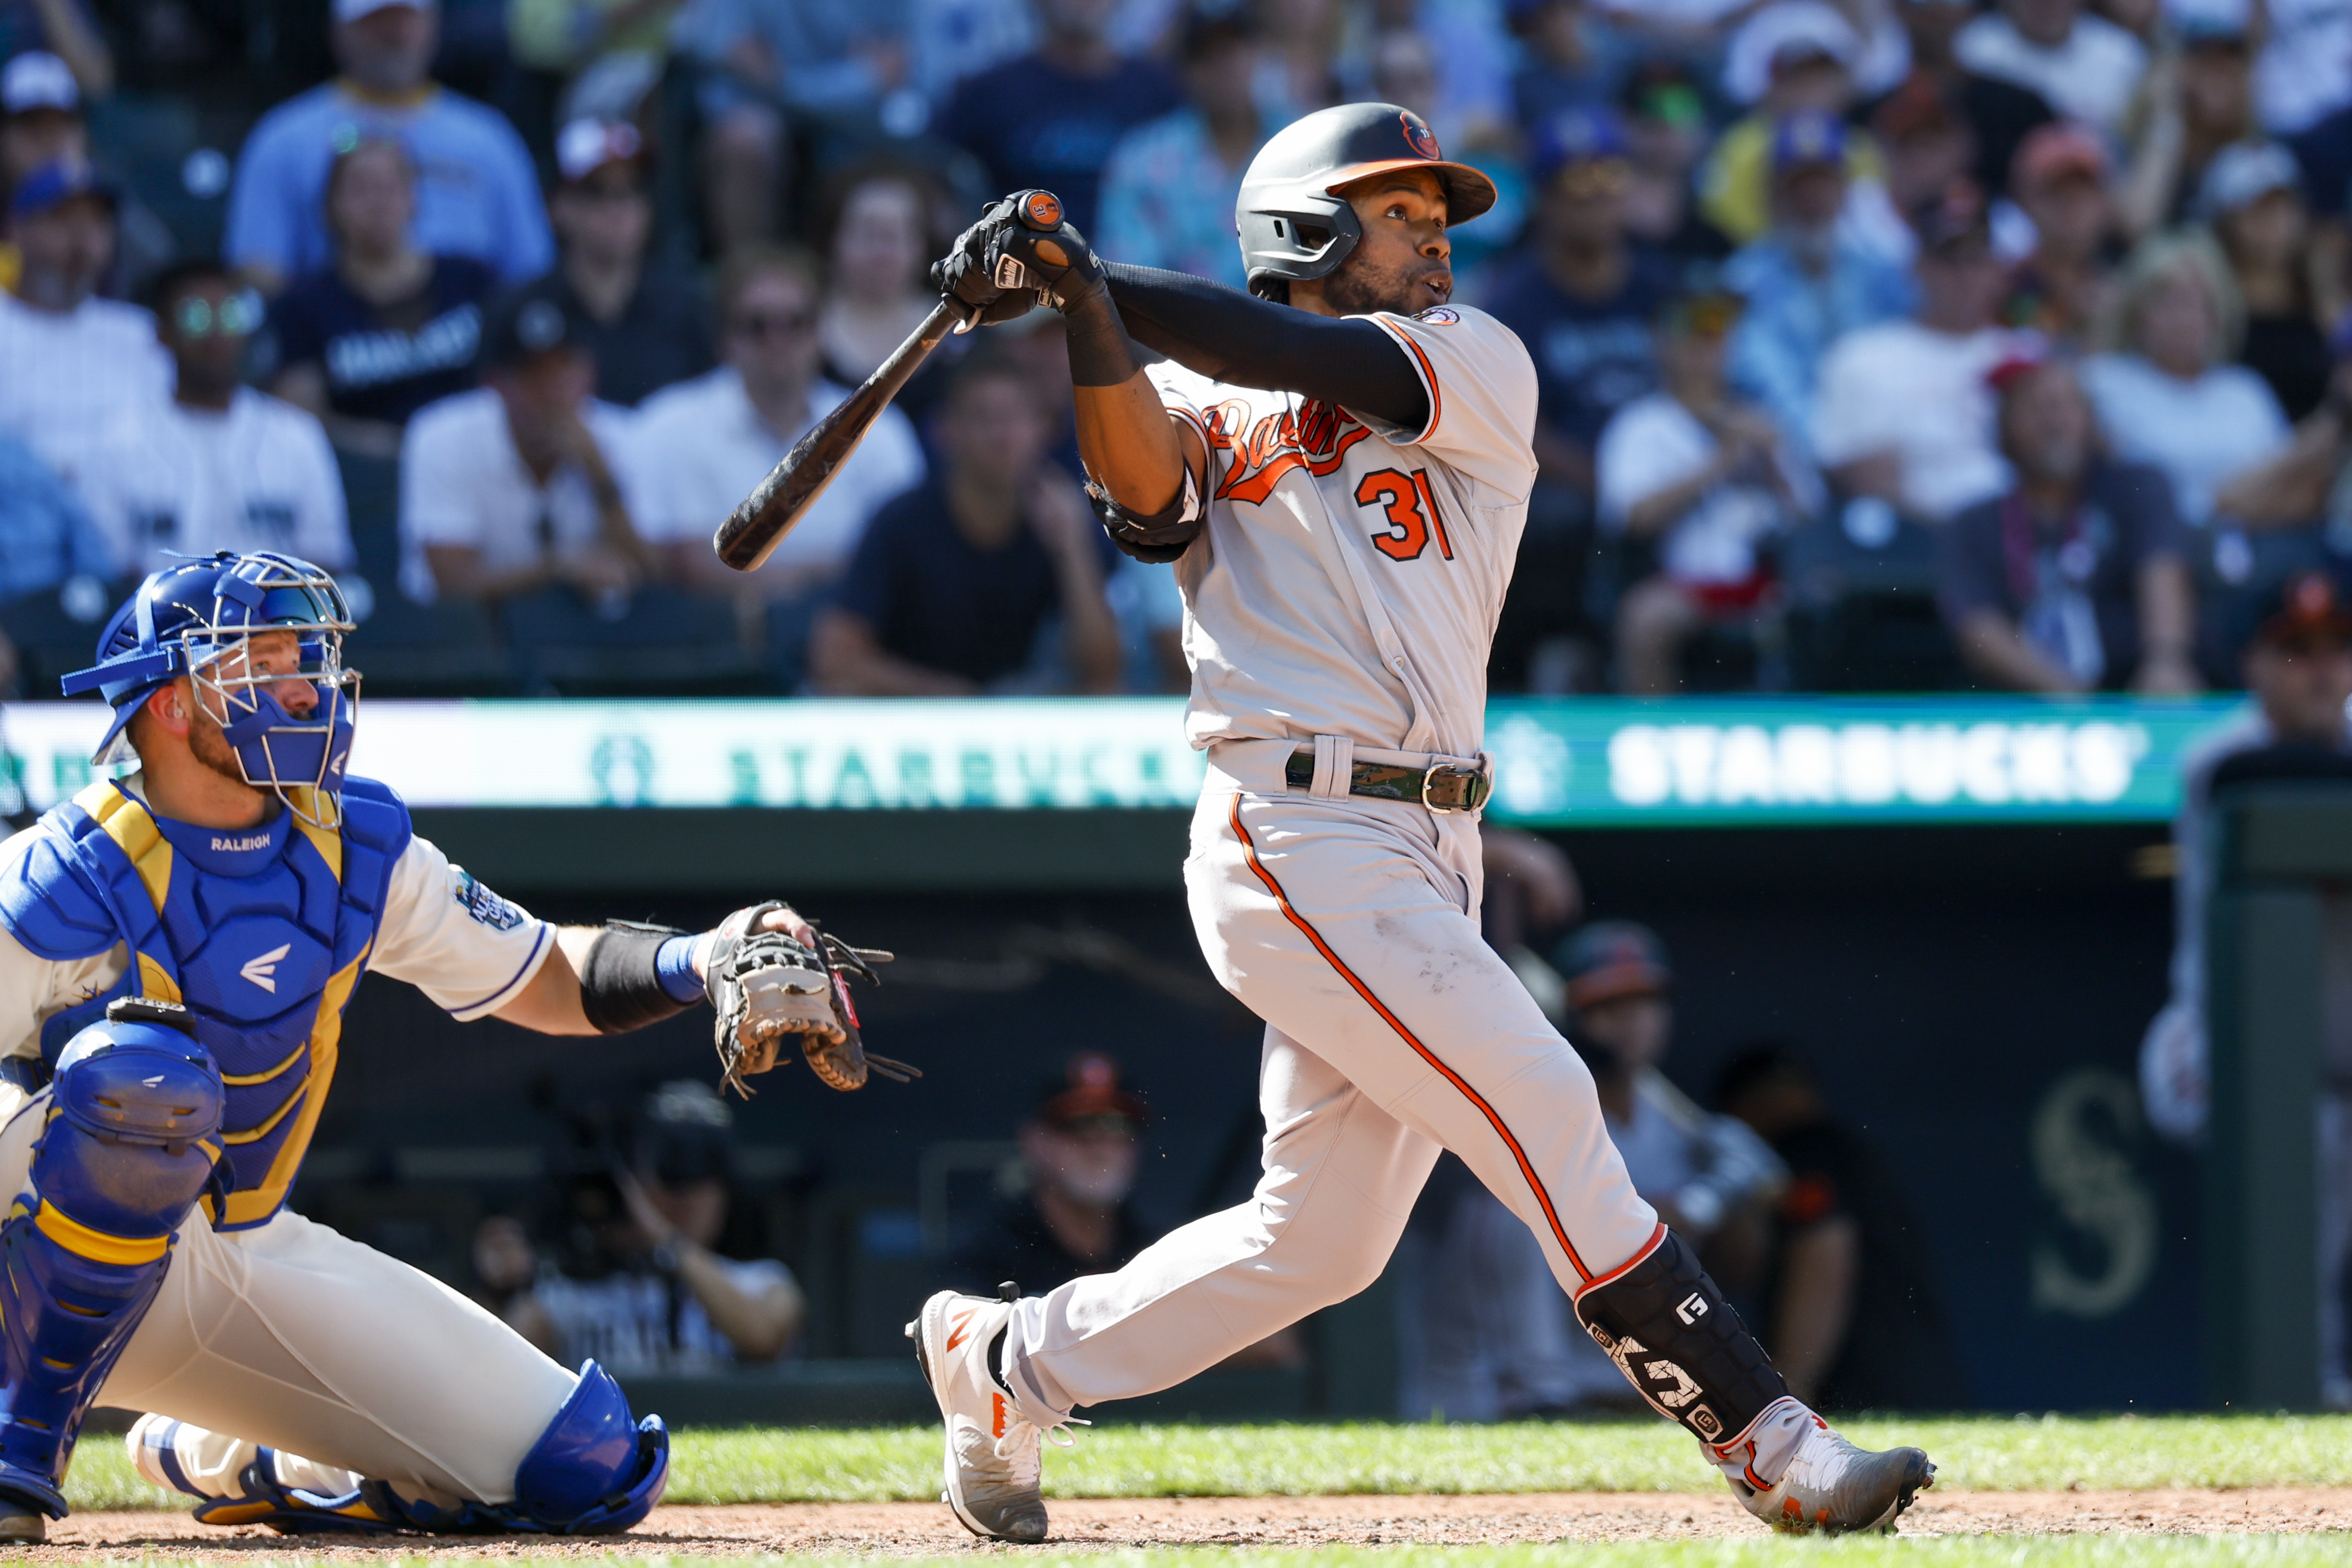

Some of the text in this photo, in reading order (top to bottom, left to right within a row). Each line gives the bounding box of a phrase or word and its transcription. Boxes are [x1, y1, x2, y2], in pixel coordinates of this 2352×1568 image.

[1032, 203, 1047, 217] 31
[1354, 468, 1454, 561] 31
[728, 743, 1209, 807] STARBUCK
[1608, 725, 2134, 804] STARBUCKS
[211, 833, 270, 851] RALEIGH
